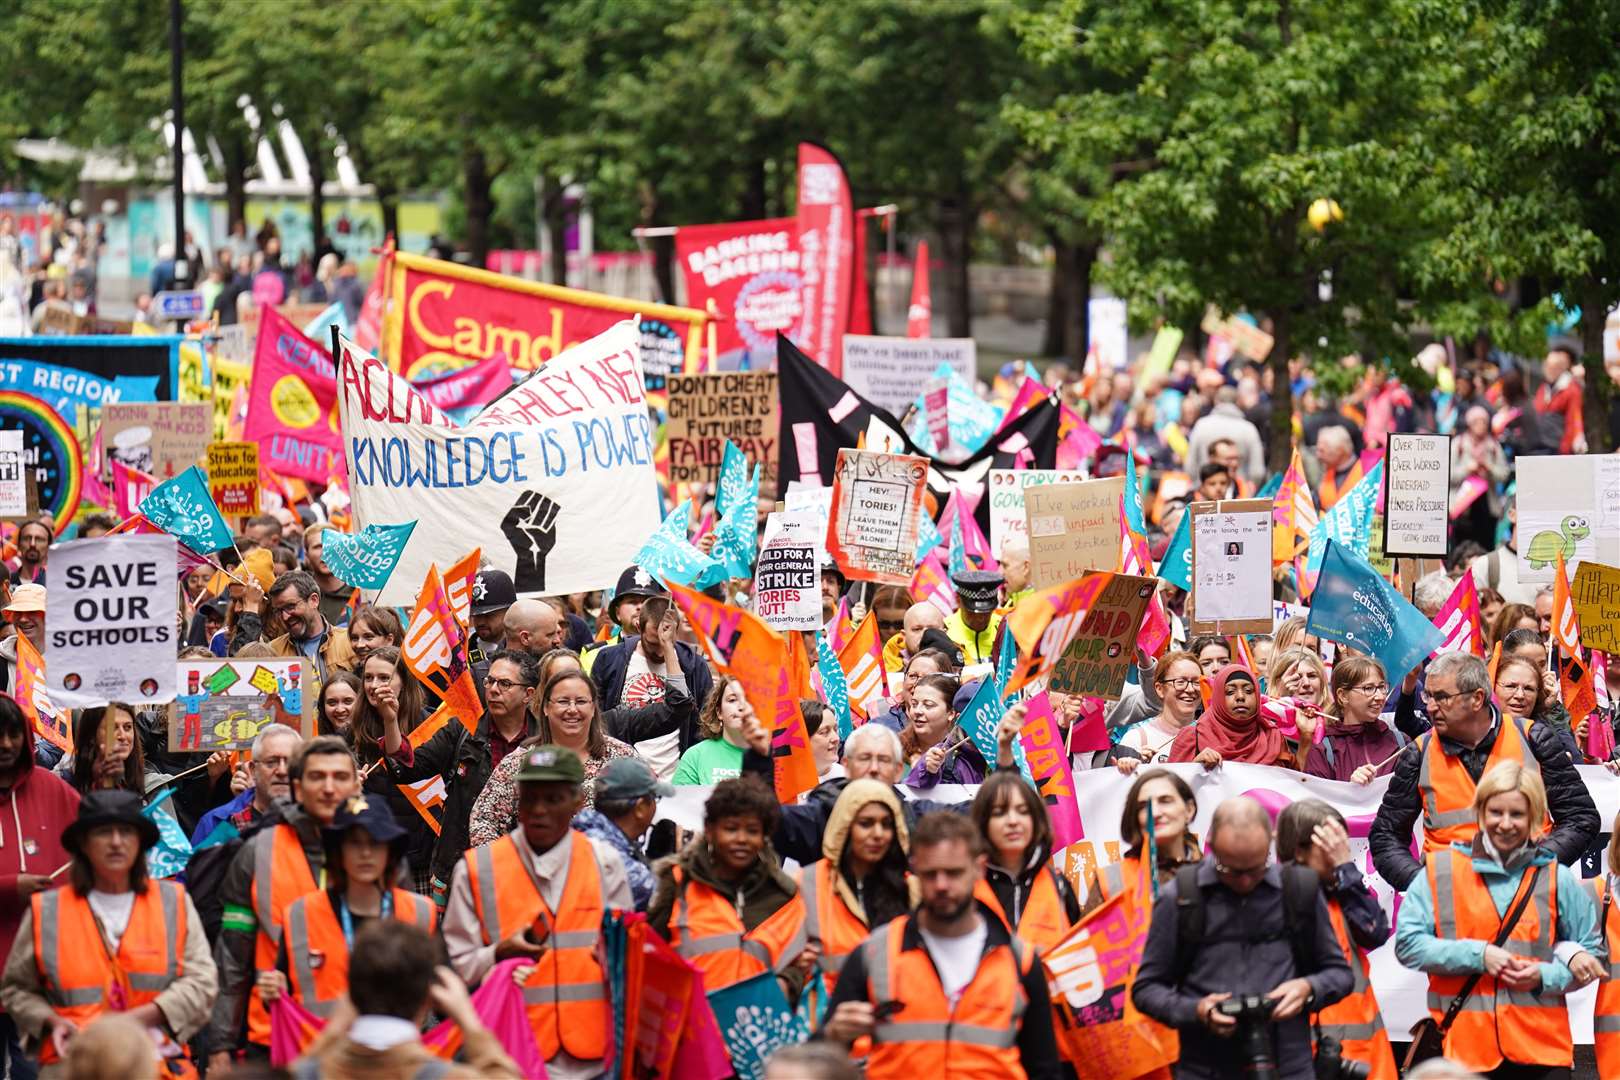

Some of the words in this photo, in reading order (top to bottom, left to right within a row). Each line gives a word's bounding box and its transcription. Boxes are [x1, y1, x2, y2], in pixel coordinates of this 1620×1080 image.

[409, 279, 585, 371] Camd
[33, 366, 122, 403] REGION
[724, 373, 777, 394] CHEAT
[208, 451, 239, 465] Strike
[242, 449, 256, 465] for
[352, 431, 528, 489] KNOWLEDGE
[538, 427, 567, 479] IS
[573, 413, 652, 472] POWER
[669, 437, 723, 464] FAIR
[209, 465, 257, 480] education
[1413, 458, 1441, 471] WORKED
[860, 500, 898, 512] TORIES!
[1031, 494, 1064, 514] I've
[1071, 493, 1113, 513] worked
[853, 515, 876, 525] LEAVE
[879, 518, 899, 527] THEM
[1067, 515, 1105, 532] unpaid
[761, 549, 782, 561] UILD
[784, 549, 804, 560] FOR
[805, 549, 814, 560] A
[1036, 540, 1066, 553] since
[65, 562, 158, 590] SAVE
[775, 561, 814, 571] GENERAL
[1040, 562, 1062, 581] Fix
[759, 572, 814, 590] STRIKE
[759, 589, 801, 605] TORIES
[73, 596, 150, 622] OUR
[759, 602, 786, 617] OUT!
[1352, 589, 1394, 640] education
[1080, 608, 1132, 639] UND
[1367, 611, 1384, 632] union
[1577, 613, 1614, 644] appy
[52, 625, 170, 648] SCHOOLS
[404, 607, 453, 674] UP
[1050, 657, 1129, 698] SCHOOLS
[1020, 715, 1074, 799] PAY
